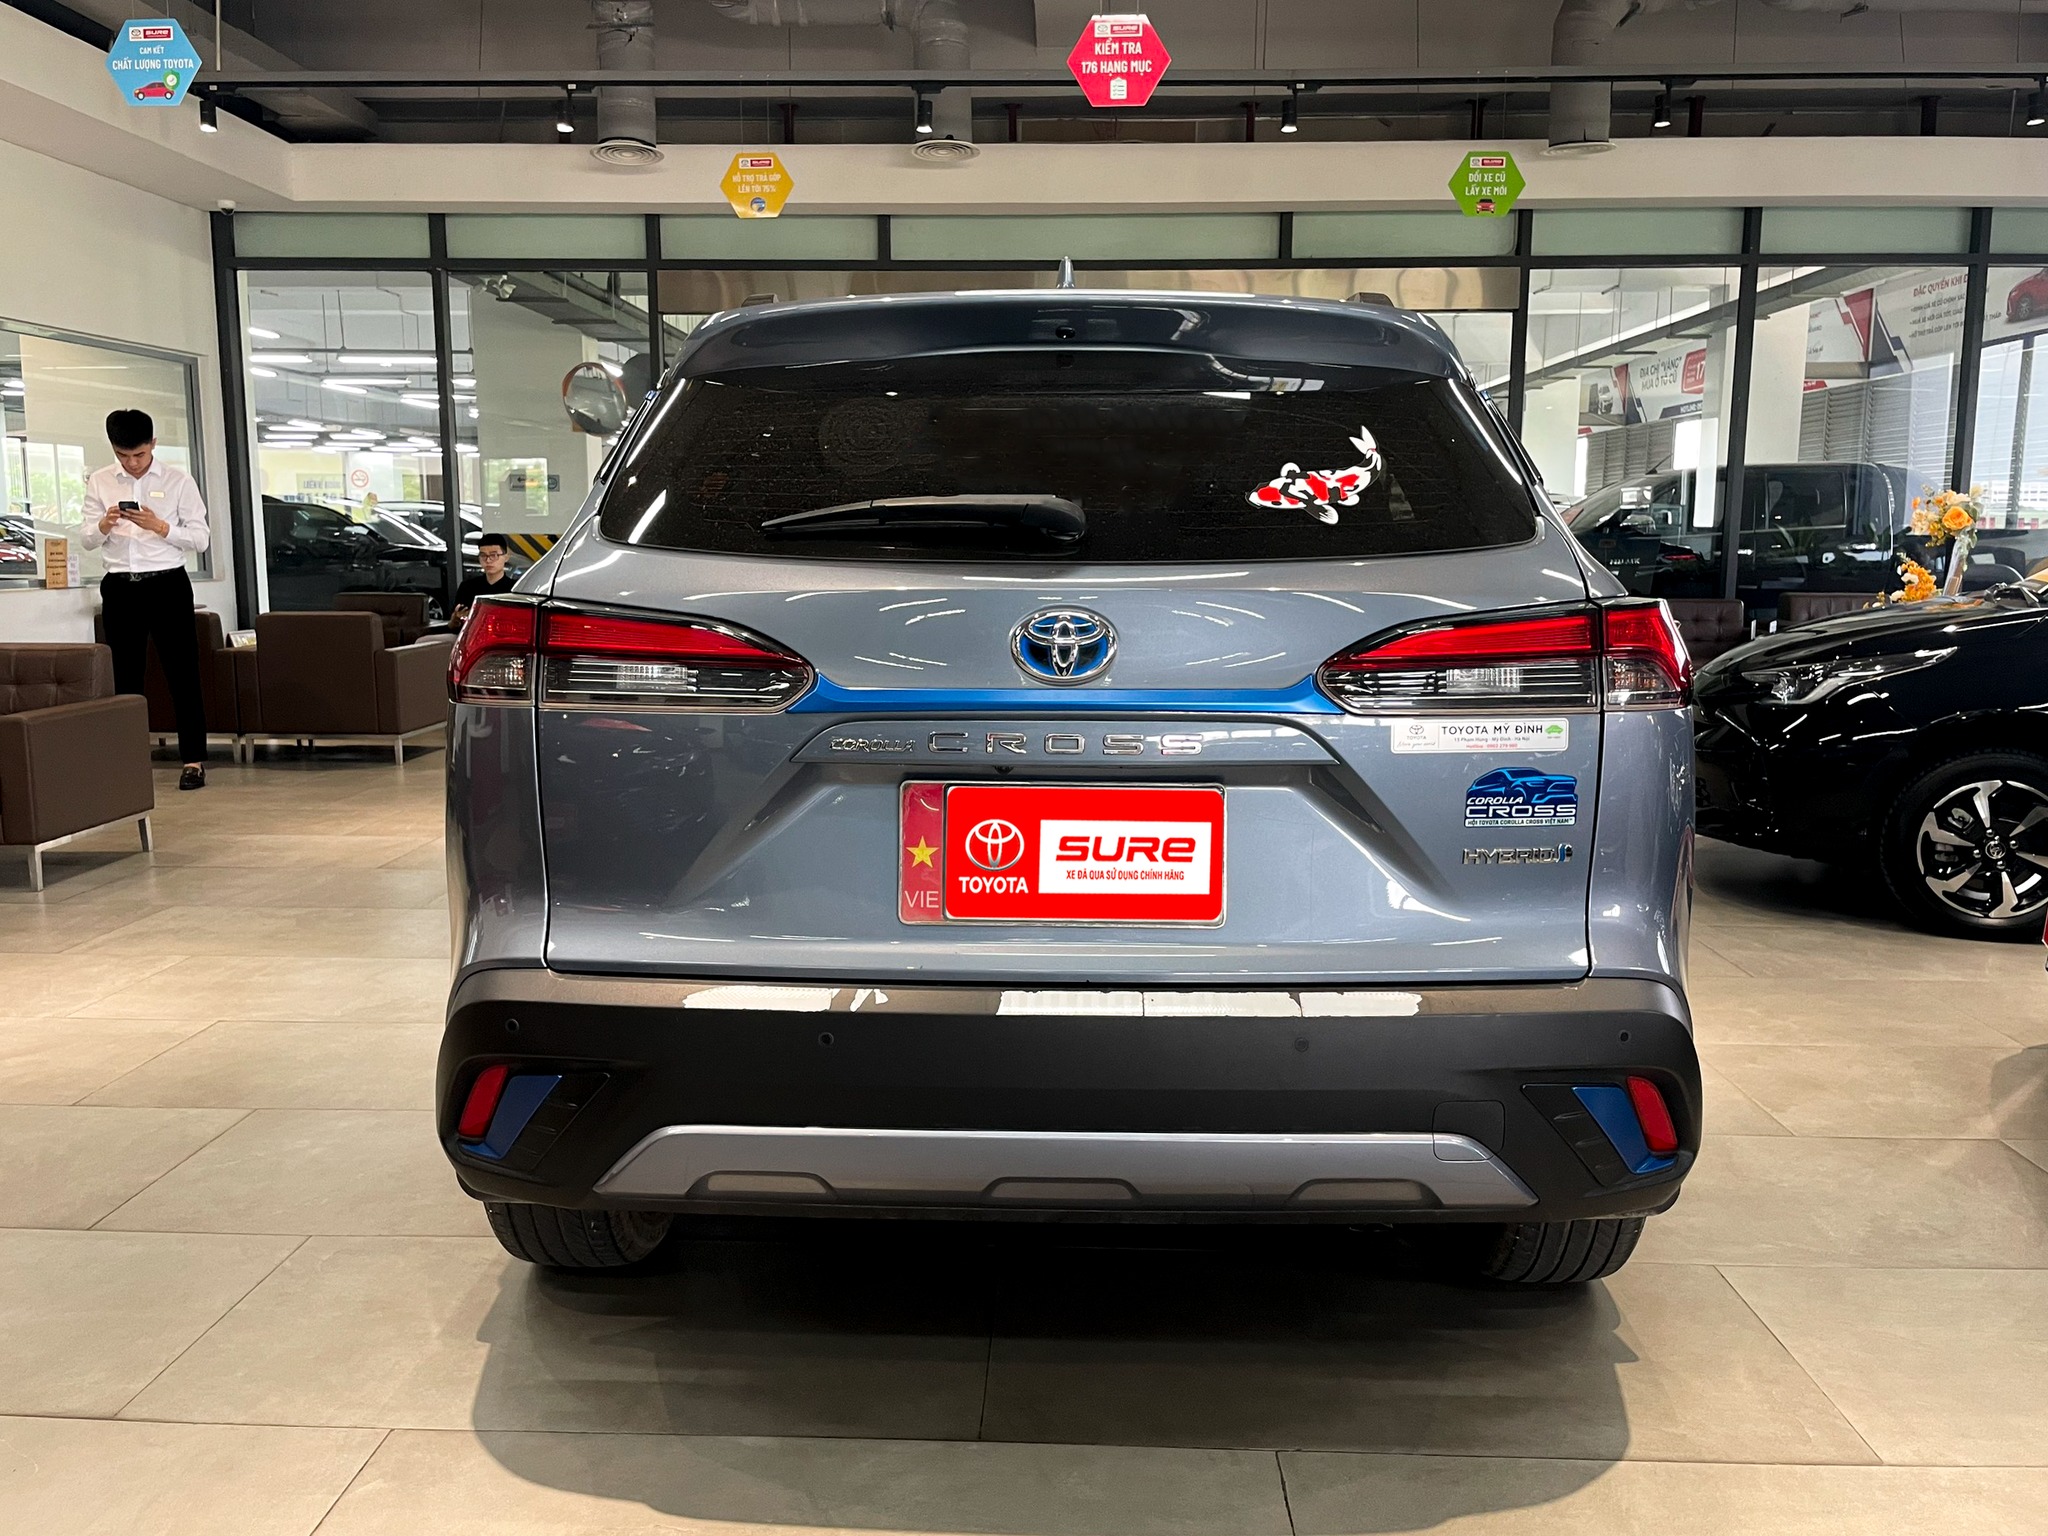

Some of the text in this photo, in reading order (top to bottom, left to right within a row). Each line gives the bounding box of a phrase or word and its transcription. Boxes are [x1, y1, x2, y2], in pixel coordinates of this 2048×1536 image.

[153, 44, 164, 54] KẾT
[1094, 37, 1142, 55] KIỂM TRA
[112, 57, 194, 72] CHẤT LƯỢNG TOYOTA
[1081, 59, 1152, 77] 176 HẠNG MỤC
[1483, 173, 1494, 182] XE
[1465, 184, 1507, 196] LẤY XE MỚI
[1441, 723, 1543, 734] TOYOTA MỸ ĐÌNH
[830, 732, 1203, 756] COROLLA CROSS
[1467, 796, 1523, 805] COROLLA
[1466, 804, 1576, 818] CROSS
[1462, 848, 1558, 864] HYBRID
[1066, 870, 1076, 879] XE
[1077, 868, 1088, 879] ĐÃ
[1089, 870, 1104, 880] QUA
[1140, 868, 1162, 880] CHÍNH
[1164, 869, 1184, 880] HÃNG
[959, 877, 1029, 894] TOYOTA
[904, 890, 939, 909] VIE
